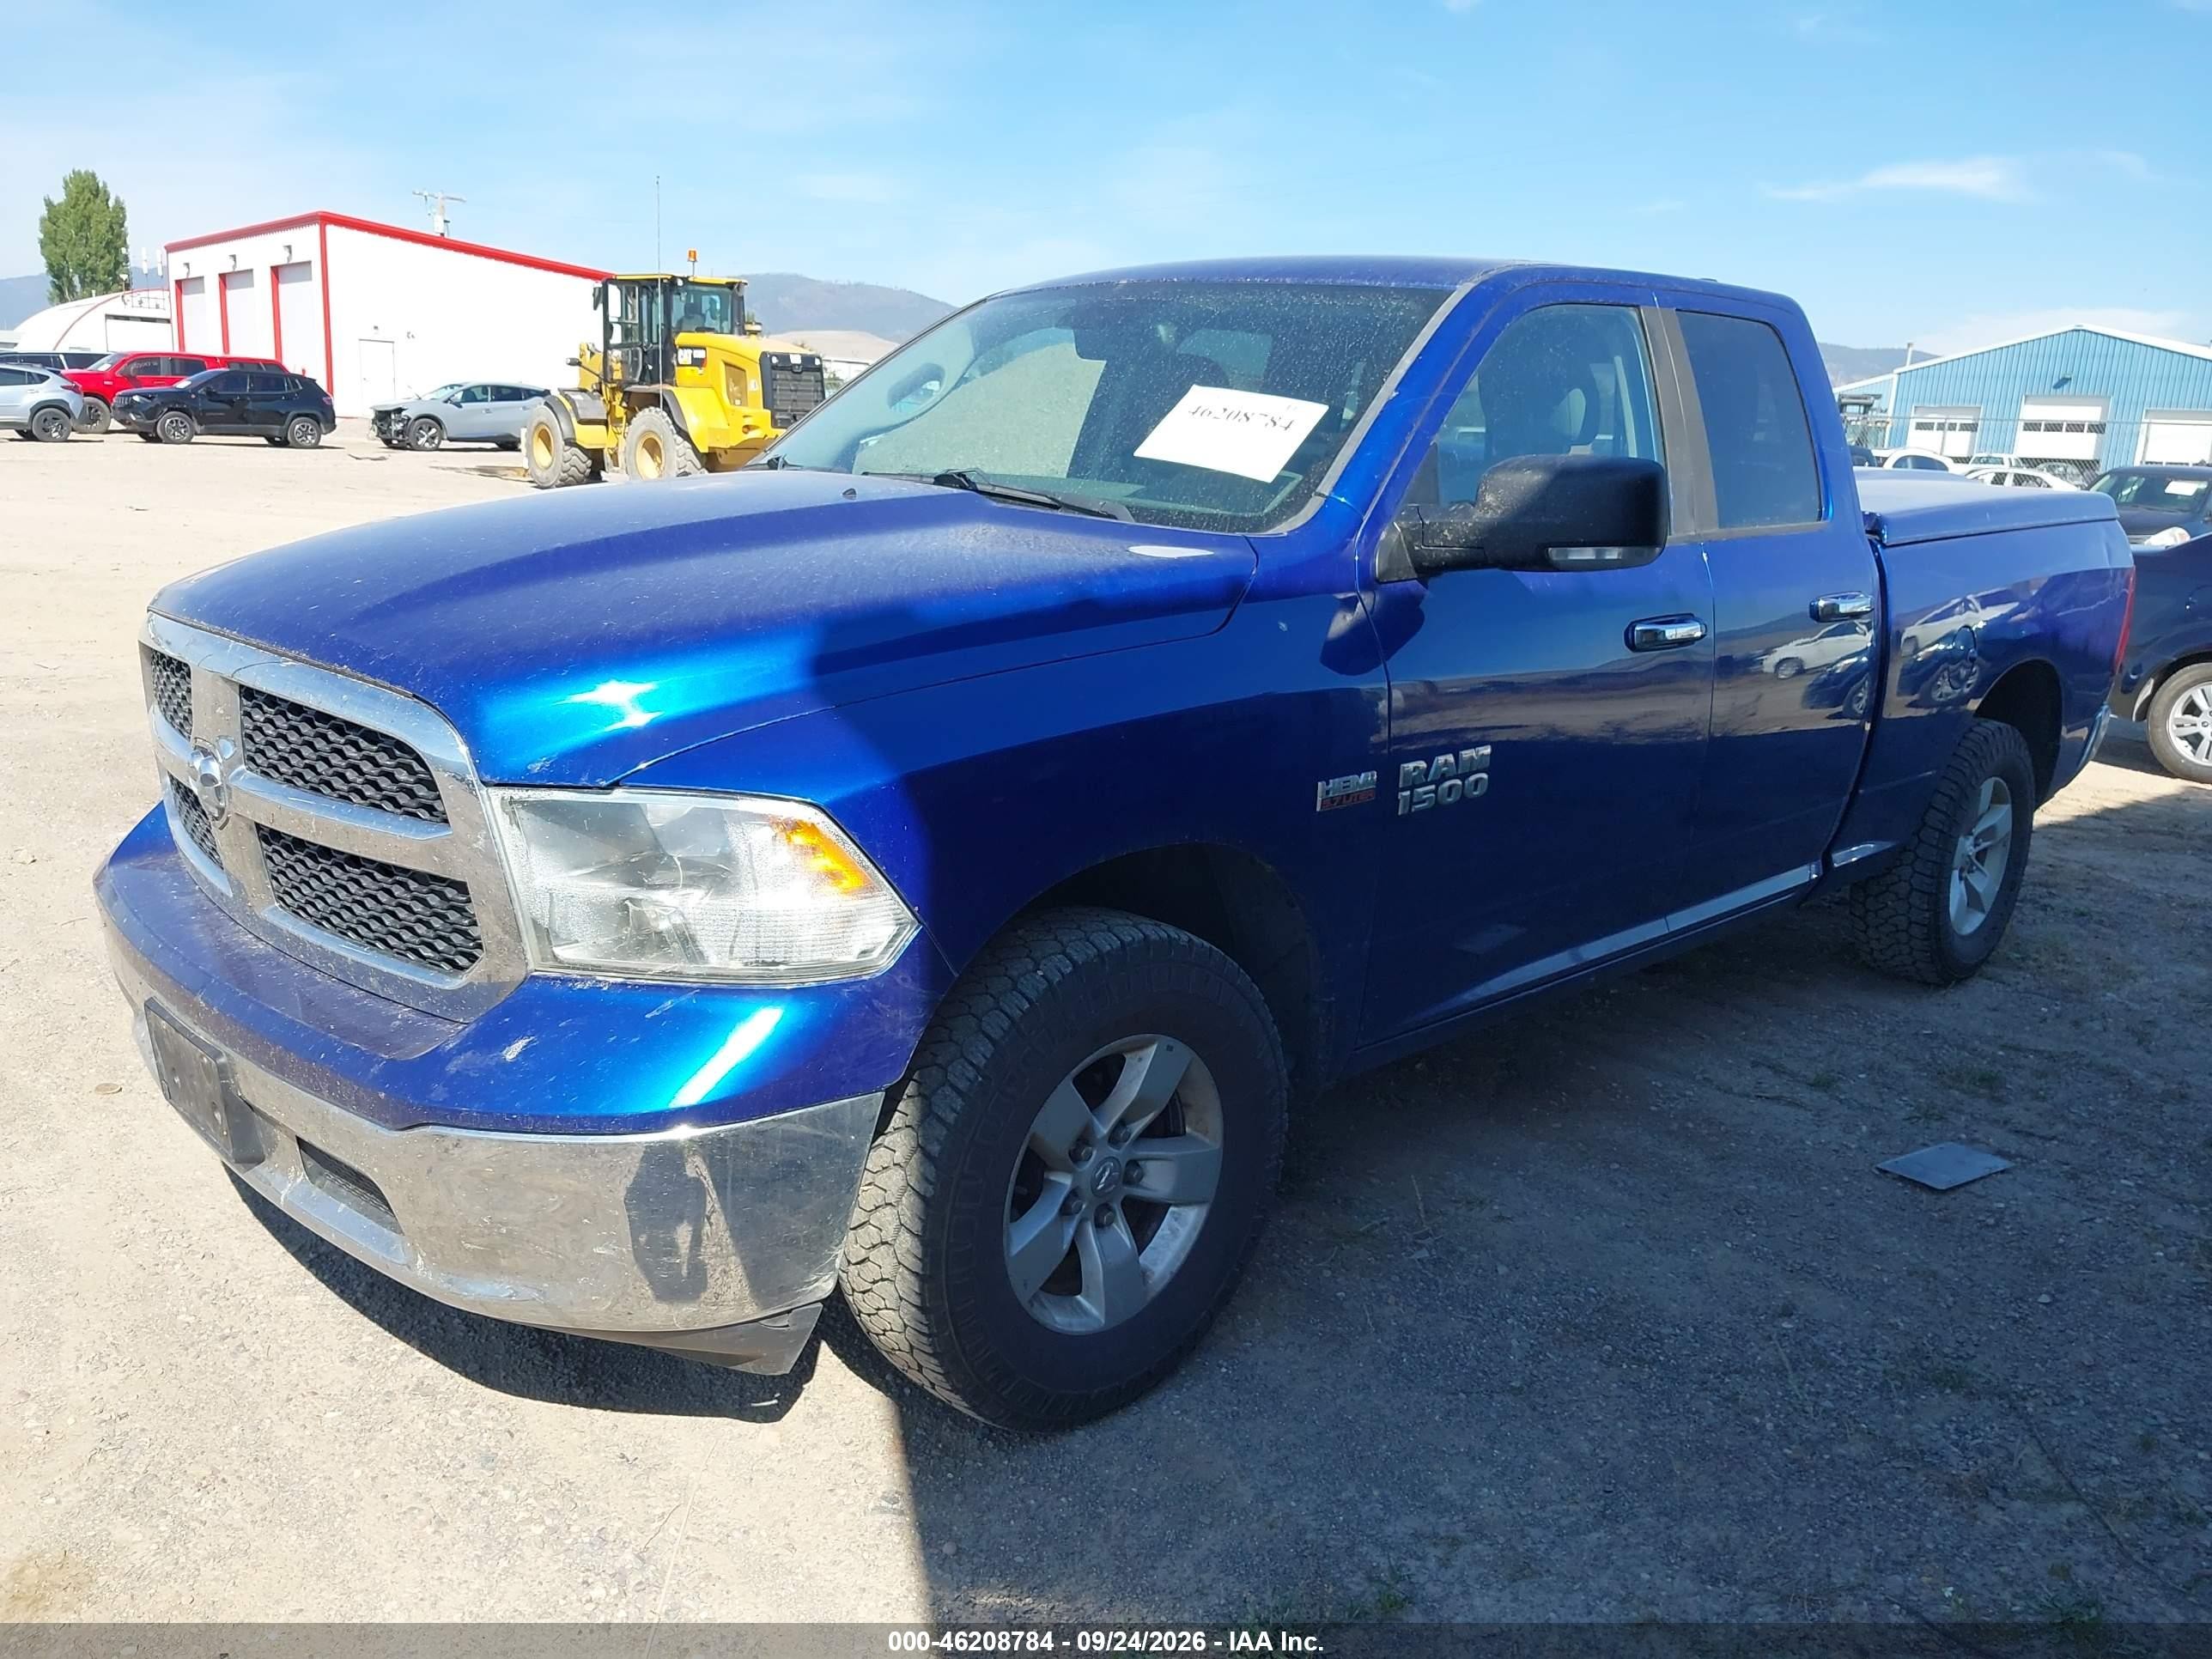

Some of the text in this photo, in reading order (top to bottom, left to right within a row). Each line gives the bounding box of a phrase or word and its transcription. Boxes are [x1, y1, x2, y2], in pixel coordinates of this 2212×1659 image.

[1317, 771, 1377, 799] HEMI
[1399, 745, 1492, 788] RAM
[1398, 773, 1490, 816] 1500
